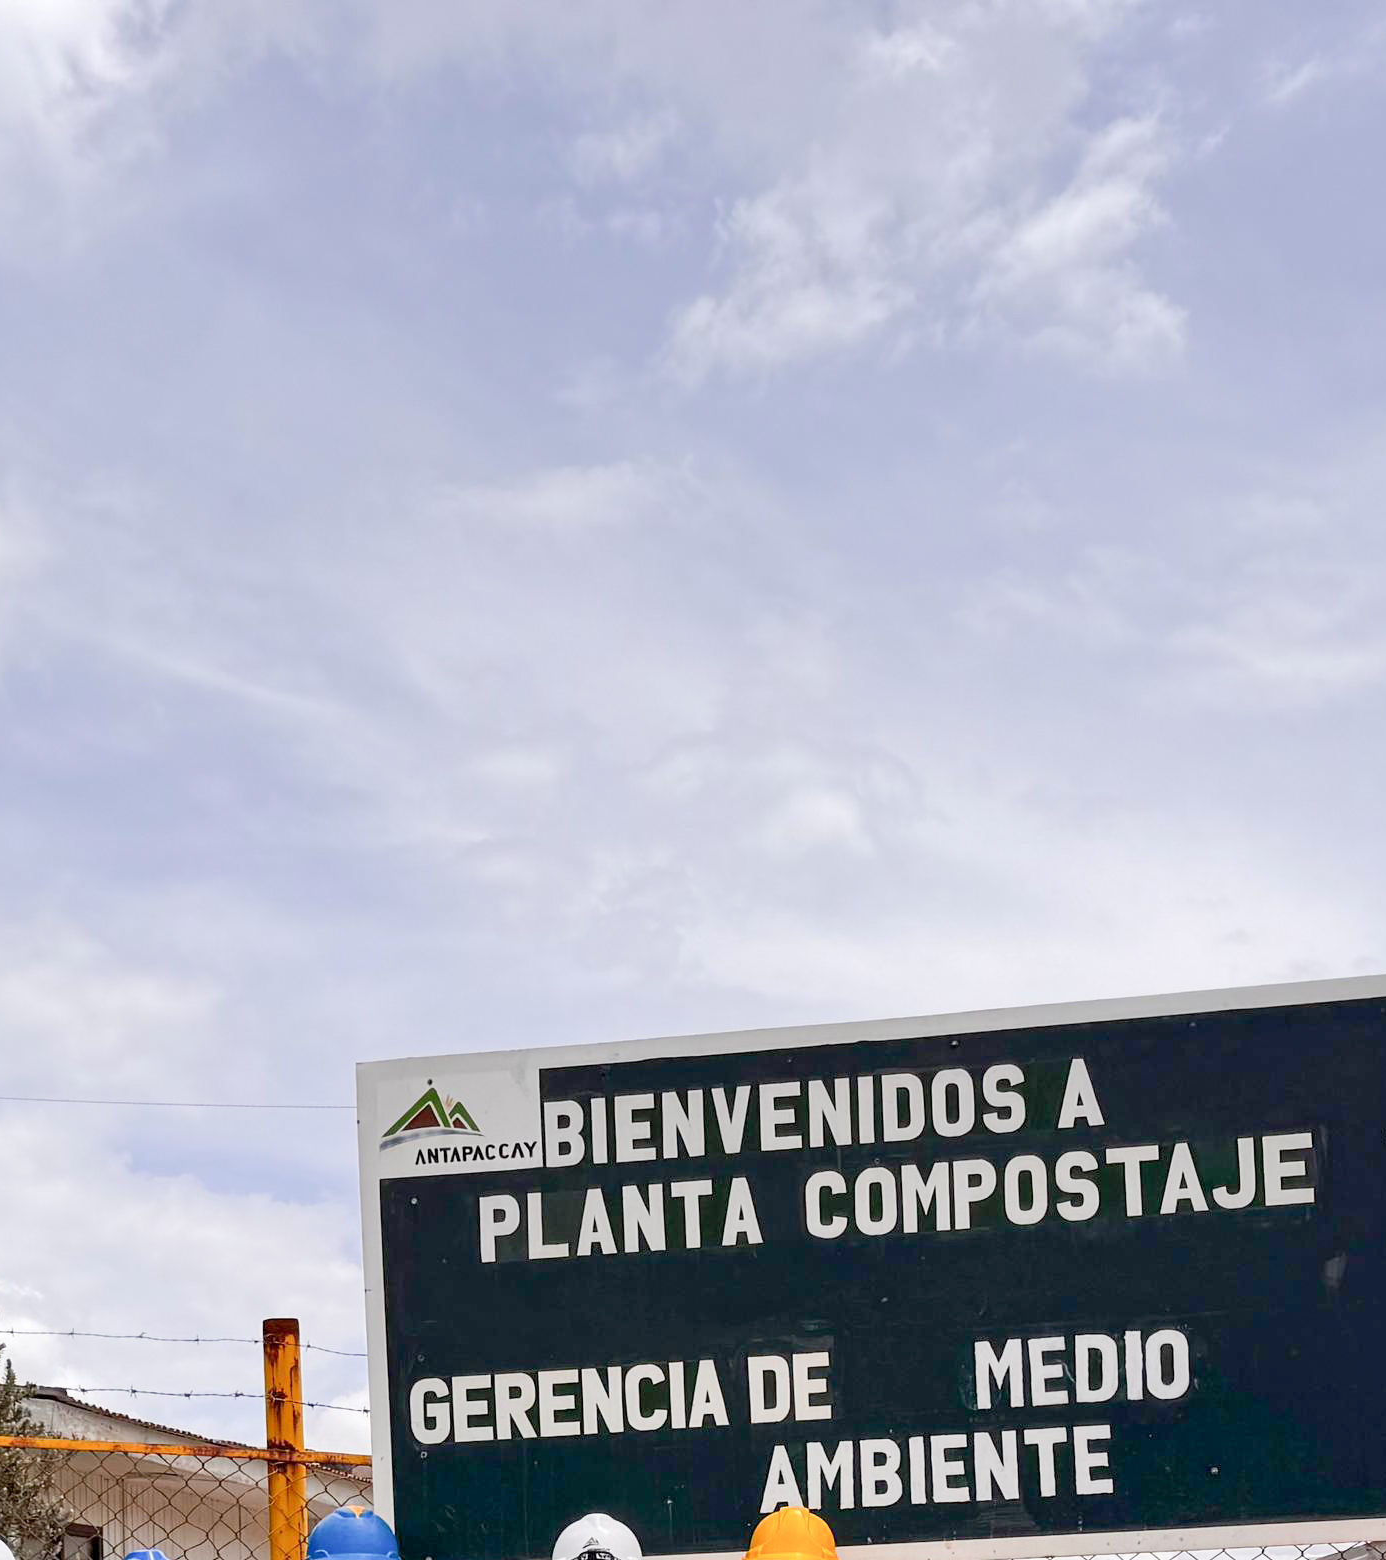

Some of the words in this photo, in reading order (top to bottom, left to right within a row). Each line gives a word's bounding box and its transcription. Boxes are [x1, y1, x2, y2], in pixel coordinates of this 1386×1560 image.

[415, 1141, 537, 1165] ANTAPACCAY
[543, 1063, 1026, 1168] BIENVENIDOS
[1057, 1057, 1106, 1129] A
[478, 1176, 764, 1264] PLANTA
[804, 1131, 1317, 1240] COMPOSTAJE
[409, 1357, 728, 1446] GERENCIA
[748, 1351, 832, 1424] DE
[974, 1328, 1191, 1411] MEDIO
[760, 1423, 1114, 1514] AMBIENTE
